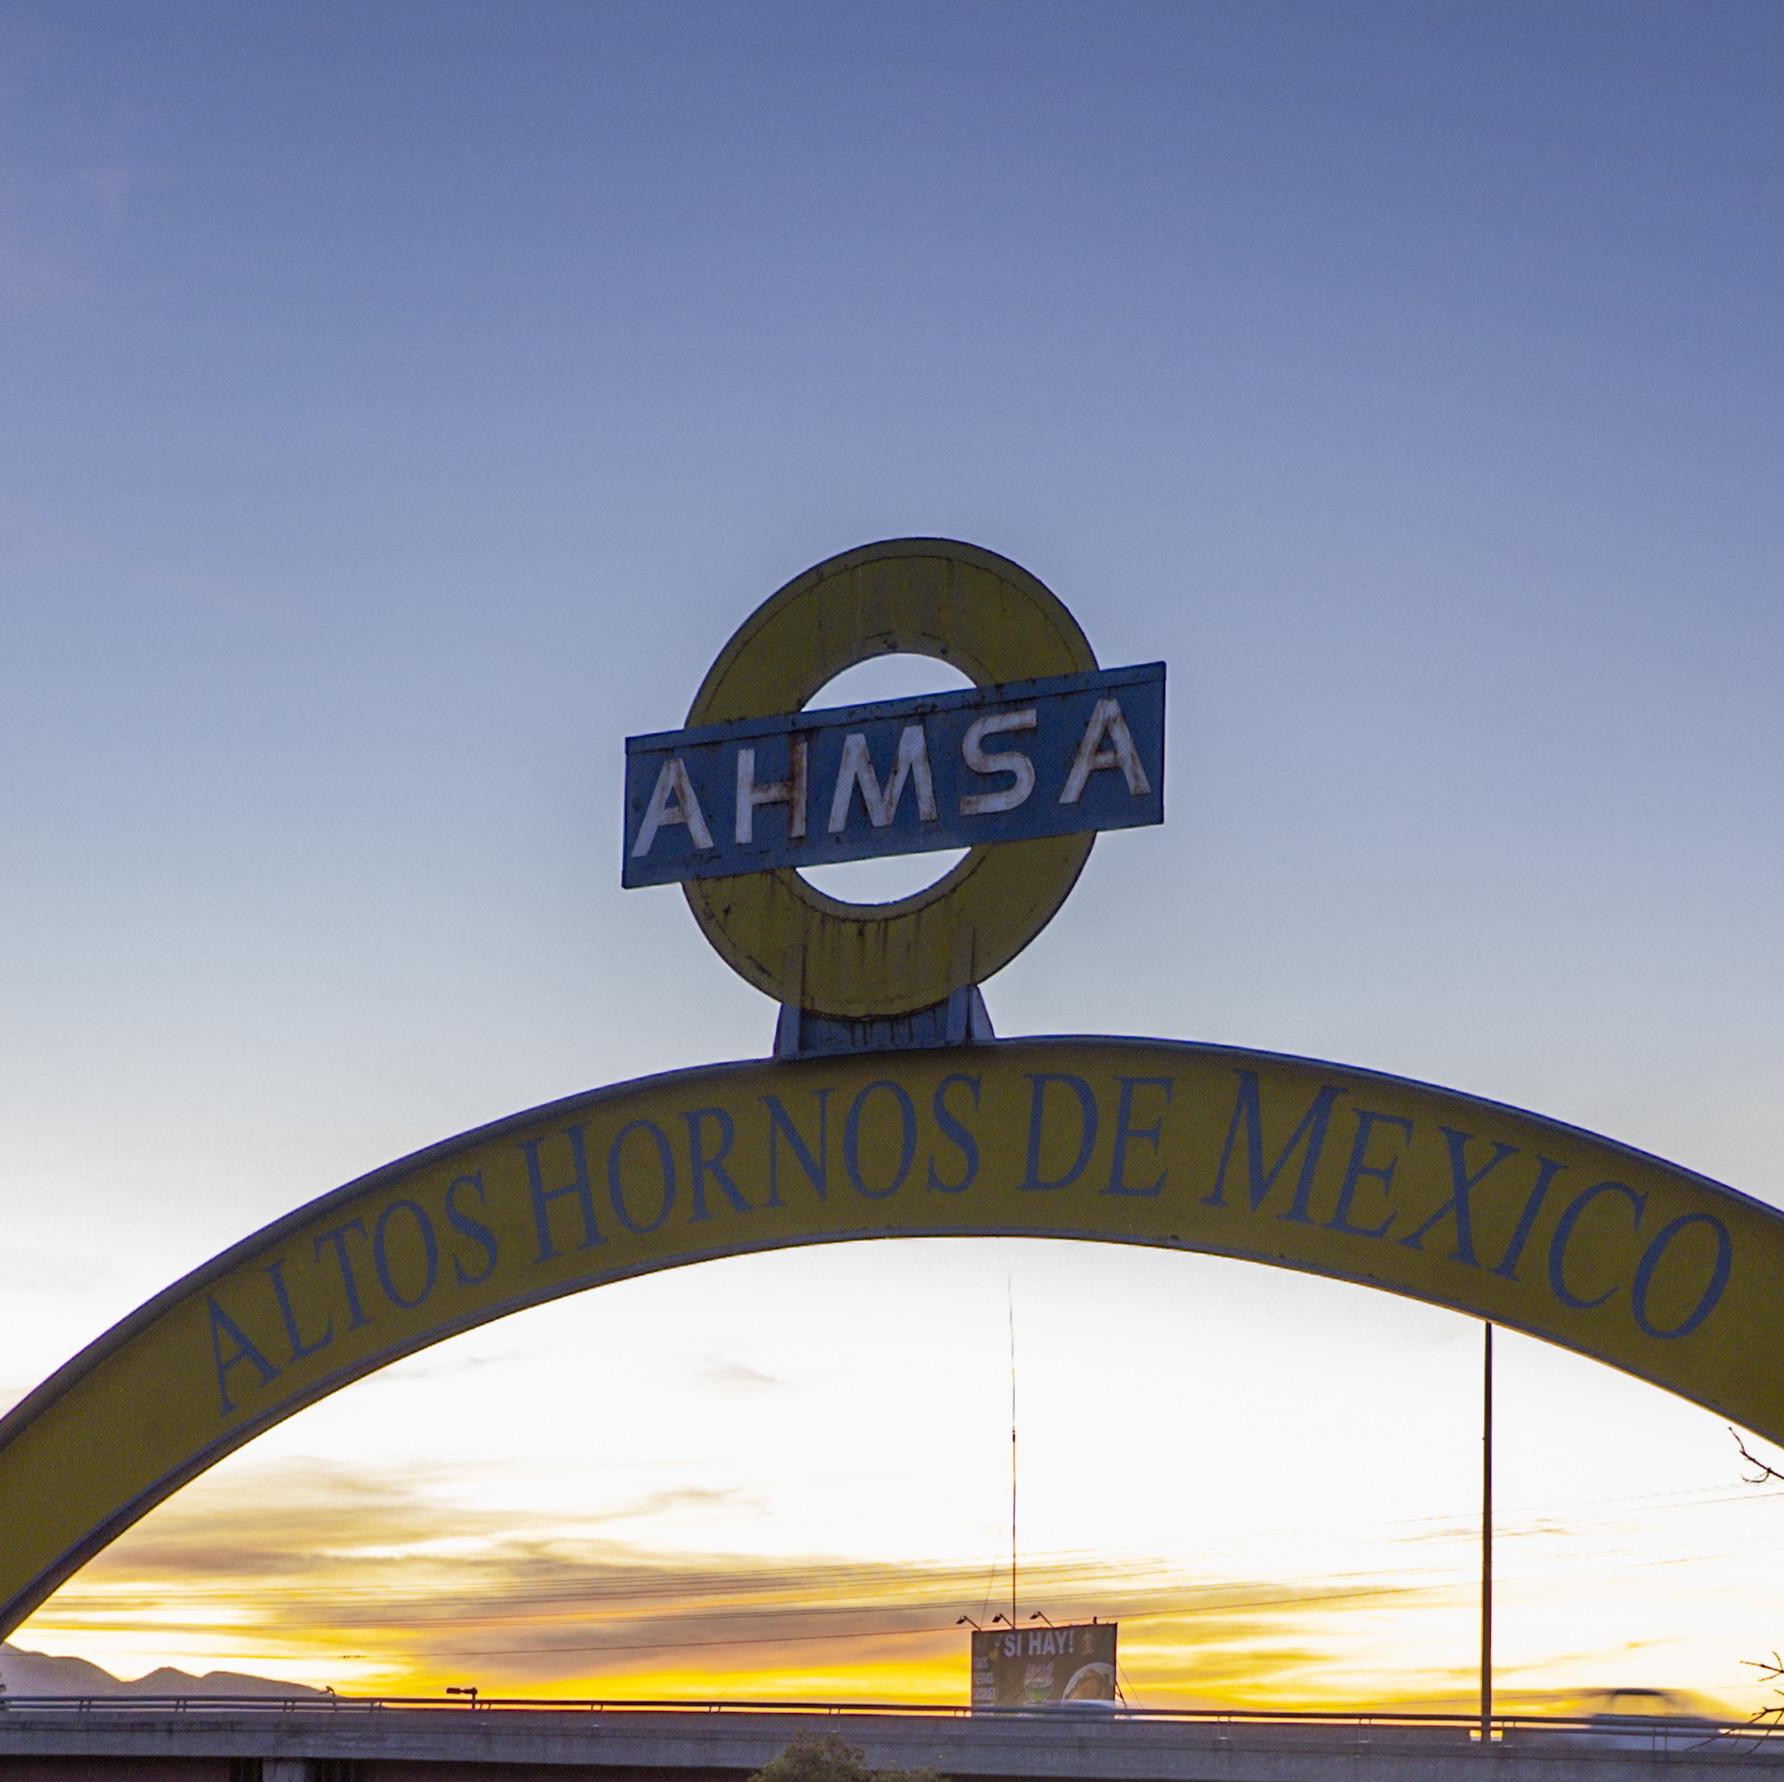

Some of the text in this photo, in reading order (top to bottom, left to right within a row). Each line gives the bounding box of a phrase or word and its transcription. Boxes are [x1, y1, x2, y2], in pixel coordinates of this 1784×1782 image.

[631, 698, 1151, 858] AHMSA
[207, 1069, 1733, 1418] ALTOS HORNOS DE MEXICO
[1028, 1630, 1075, 1656] HAY!
